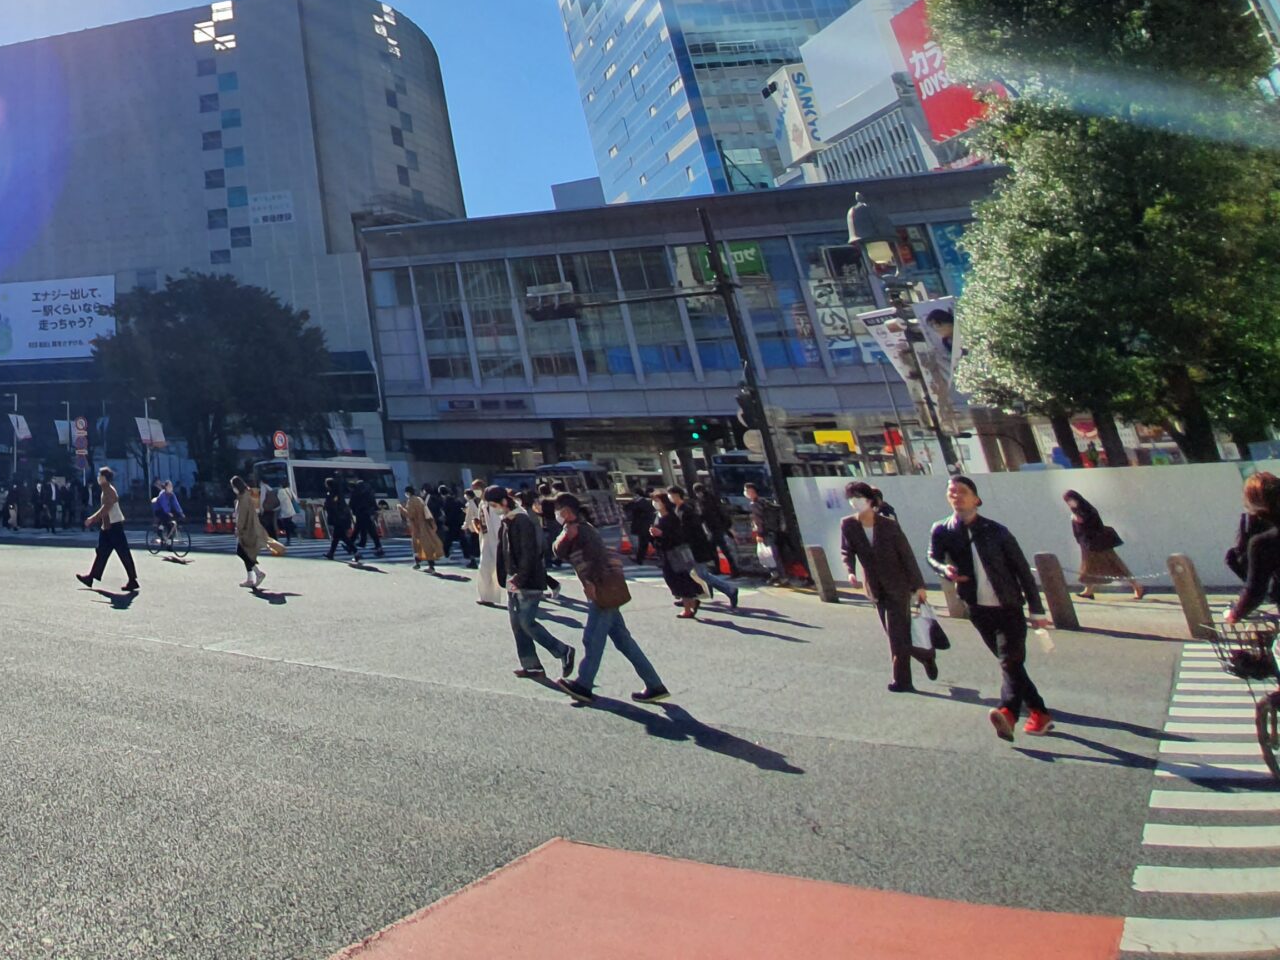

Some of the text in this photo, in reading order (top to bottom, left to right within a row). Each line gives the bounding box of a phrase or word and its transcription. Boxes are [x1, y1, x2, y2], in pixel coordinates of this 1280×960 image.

[32, 287, 102, 303] エナジー出して、
